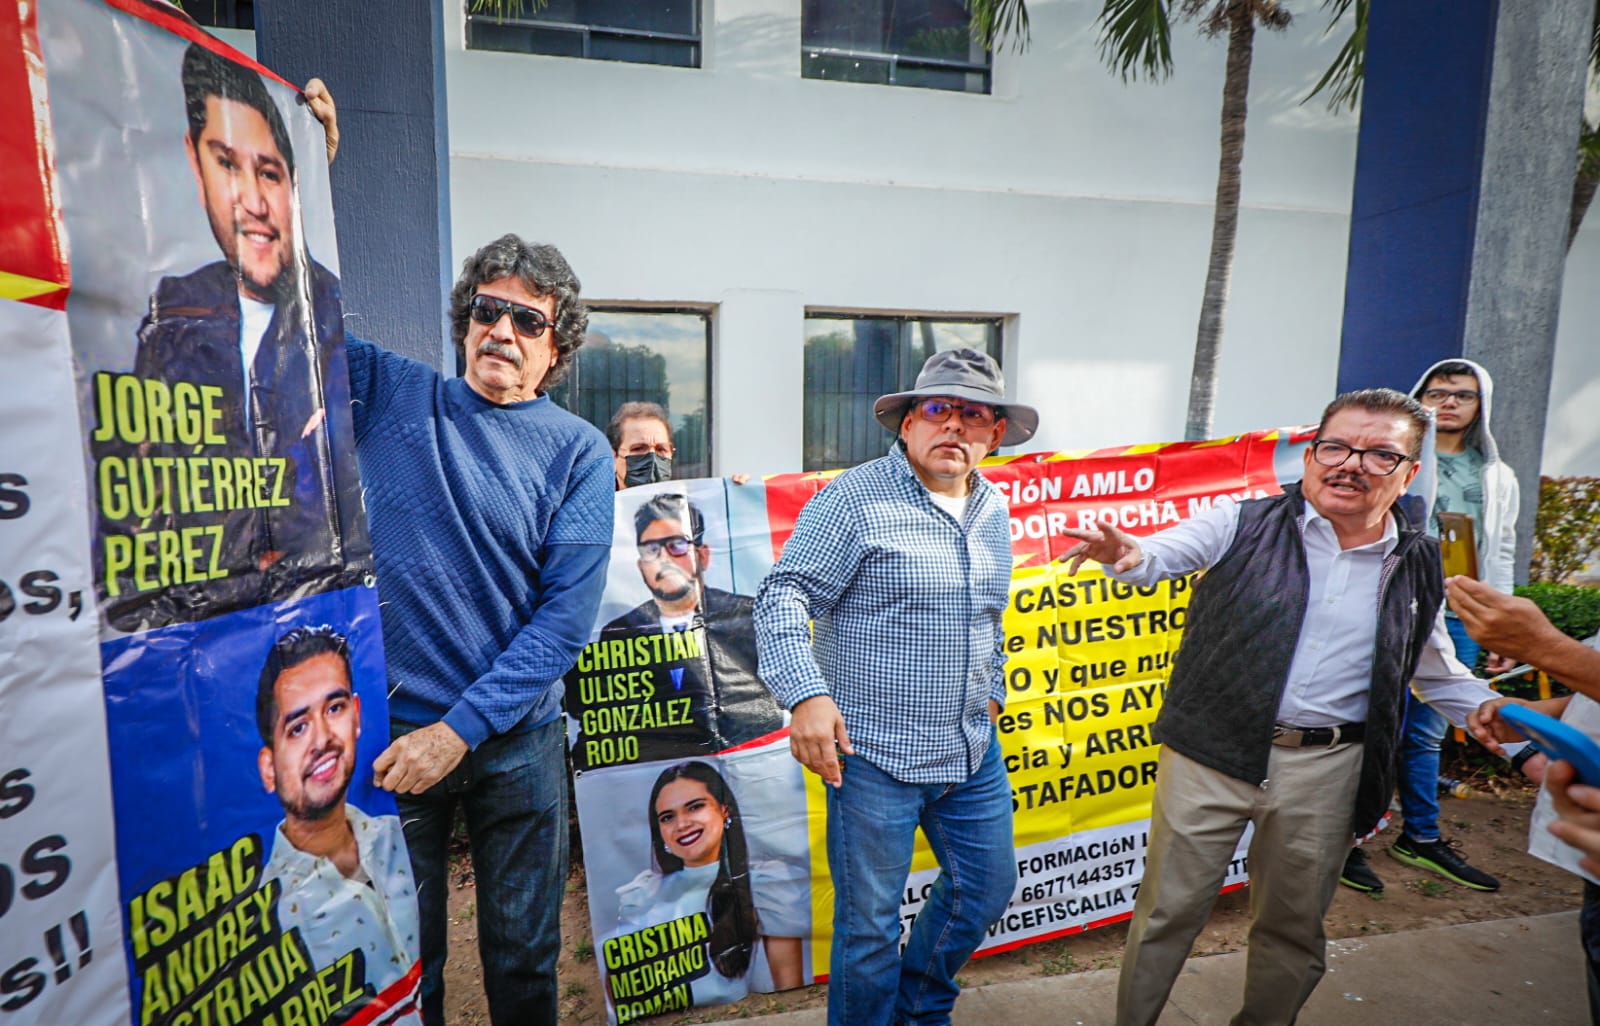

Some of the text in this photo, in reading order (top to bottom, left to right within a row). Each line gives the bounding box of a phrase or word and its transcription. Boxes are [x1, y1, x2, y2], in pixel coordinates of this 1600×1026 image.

[94, 373, 227, 446] JORGE
[100, 445, 291, 521] GUTIÉRREZ
[1069, 468, 1155, 498] AMLO
[1077, 500, 1180, 532] ROCHA
[105, 518, 229, 597] PÉREZ
[1037, 606, 1189, 649] NUESTRO
[579, 671, 656, 705] ULISES
[1043, 668, 1058, 694] y
[1071, 658, 1127, 687] que
[1138, 651, 1178, 673] nu
[582, 695, 694, 736] GONZÁLEZ
[1044, 692, 1110, 726] NOS
[586, 736, 639, 766] ROJO
[1058, 743, 1073, 769] y
[1085, 723, 1153, 758] ARR
[1018, 835, 1135, 878] FORMACIóN
[130, 836, 259, 959] ISAAC
[1021, 859, 1136, 903] 6677144357
[988, 888, 1127, 937] VICEFISCALIA
[142, 881, 278, 1026] ANDREY
[604, 912, 708, 970] CRISTINA
[610, 945, 704, 999] MEDRANO
